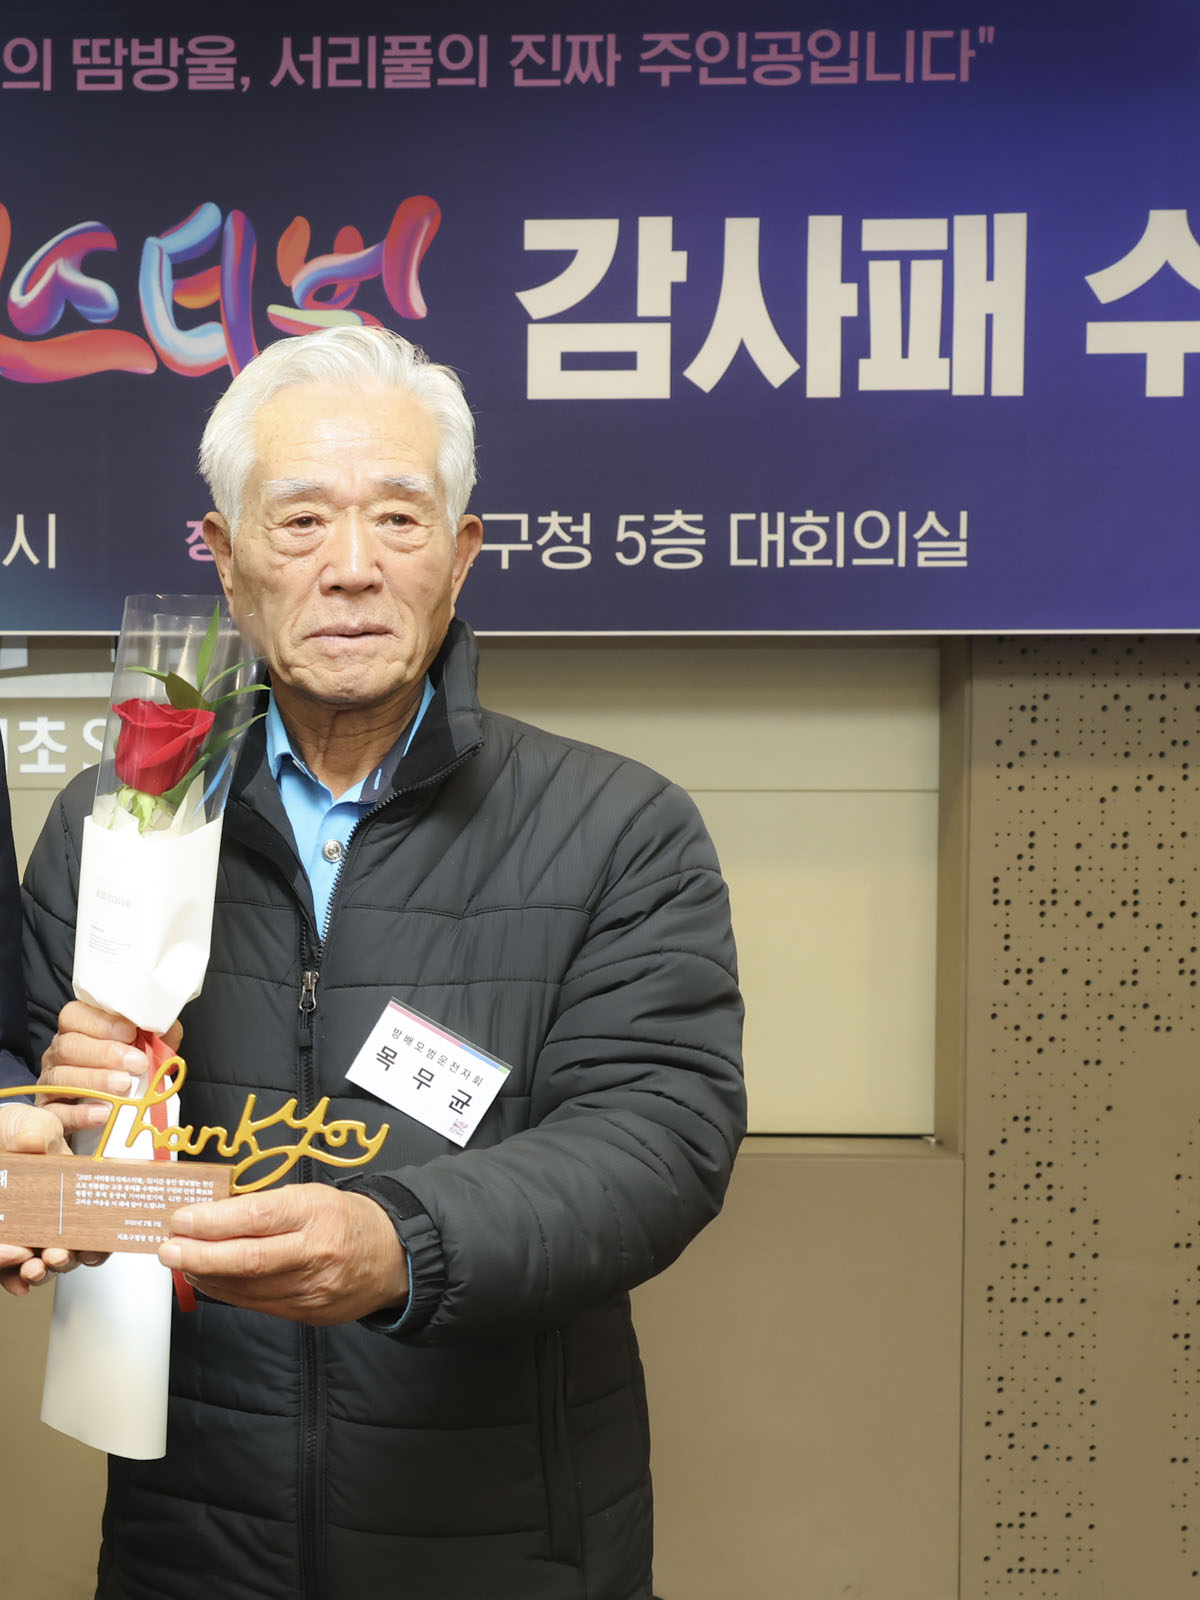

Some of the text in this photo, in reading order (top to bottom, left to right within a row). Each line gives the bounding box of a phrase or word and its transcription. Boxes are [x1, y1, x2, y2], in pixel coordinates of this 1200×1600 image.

[73, 36, 251, 92] 땀방울,
[270, 34, 489, 89] 서리풀의
[509, 32, 622, 87] 진짜
[638, 26, 996, 86] 주인공입니다"
[514, 212, 1029, 400] 감사패
[614, 510, 706, 570] 5층
[728, 509, 970, 568] 대회의실
[0, 715, 67, 774] 초
